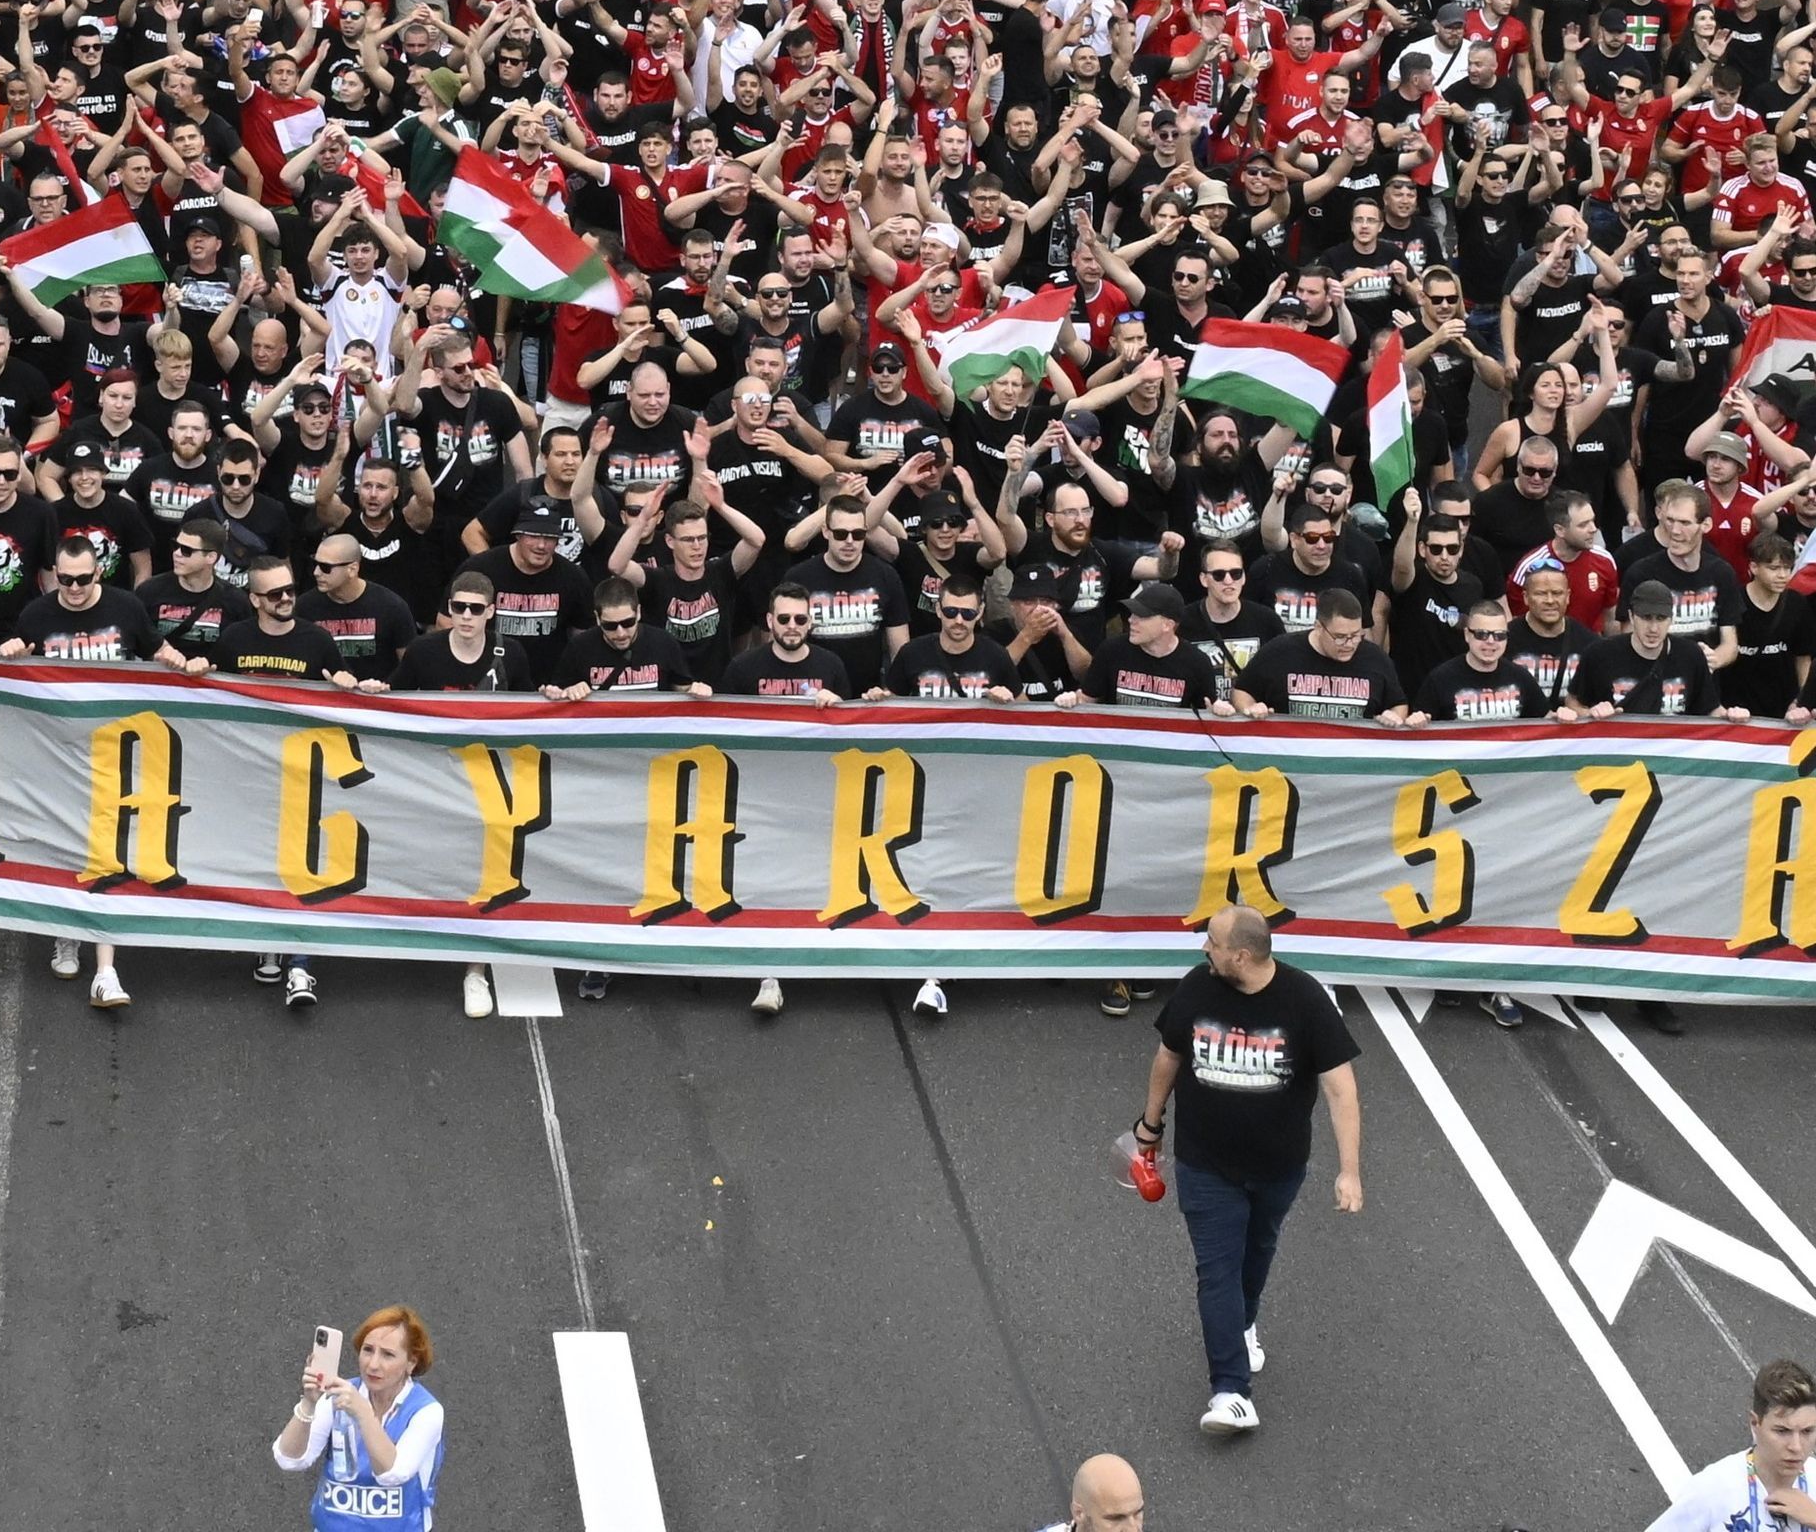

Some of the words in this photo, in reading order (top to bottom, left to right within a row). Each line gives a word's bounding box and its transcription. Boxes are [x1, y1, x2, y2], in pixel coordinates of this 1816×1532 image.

[237, 655, 307, 672] CARPATHIAN
[1287, 673, 1371, 699] CARPATHIAN
[326, 1486, 401, 1516] POLICE
